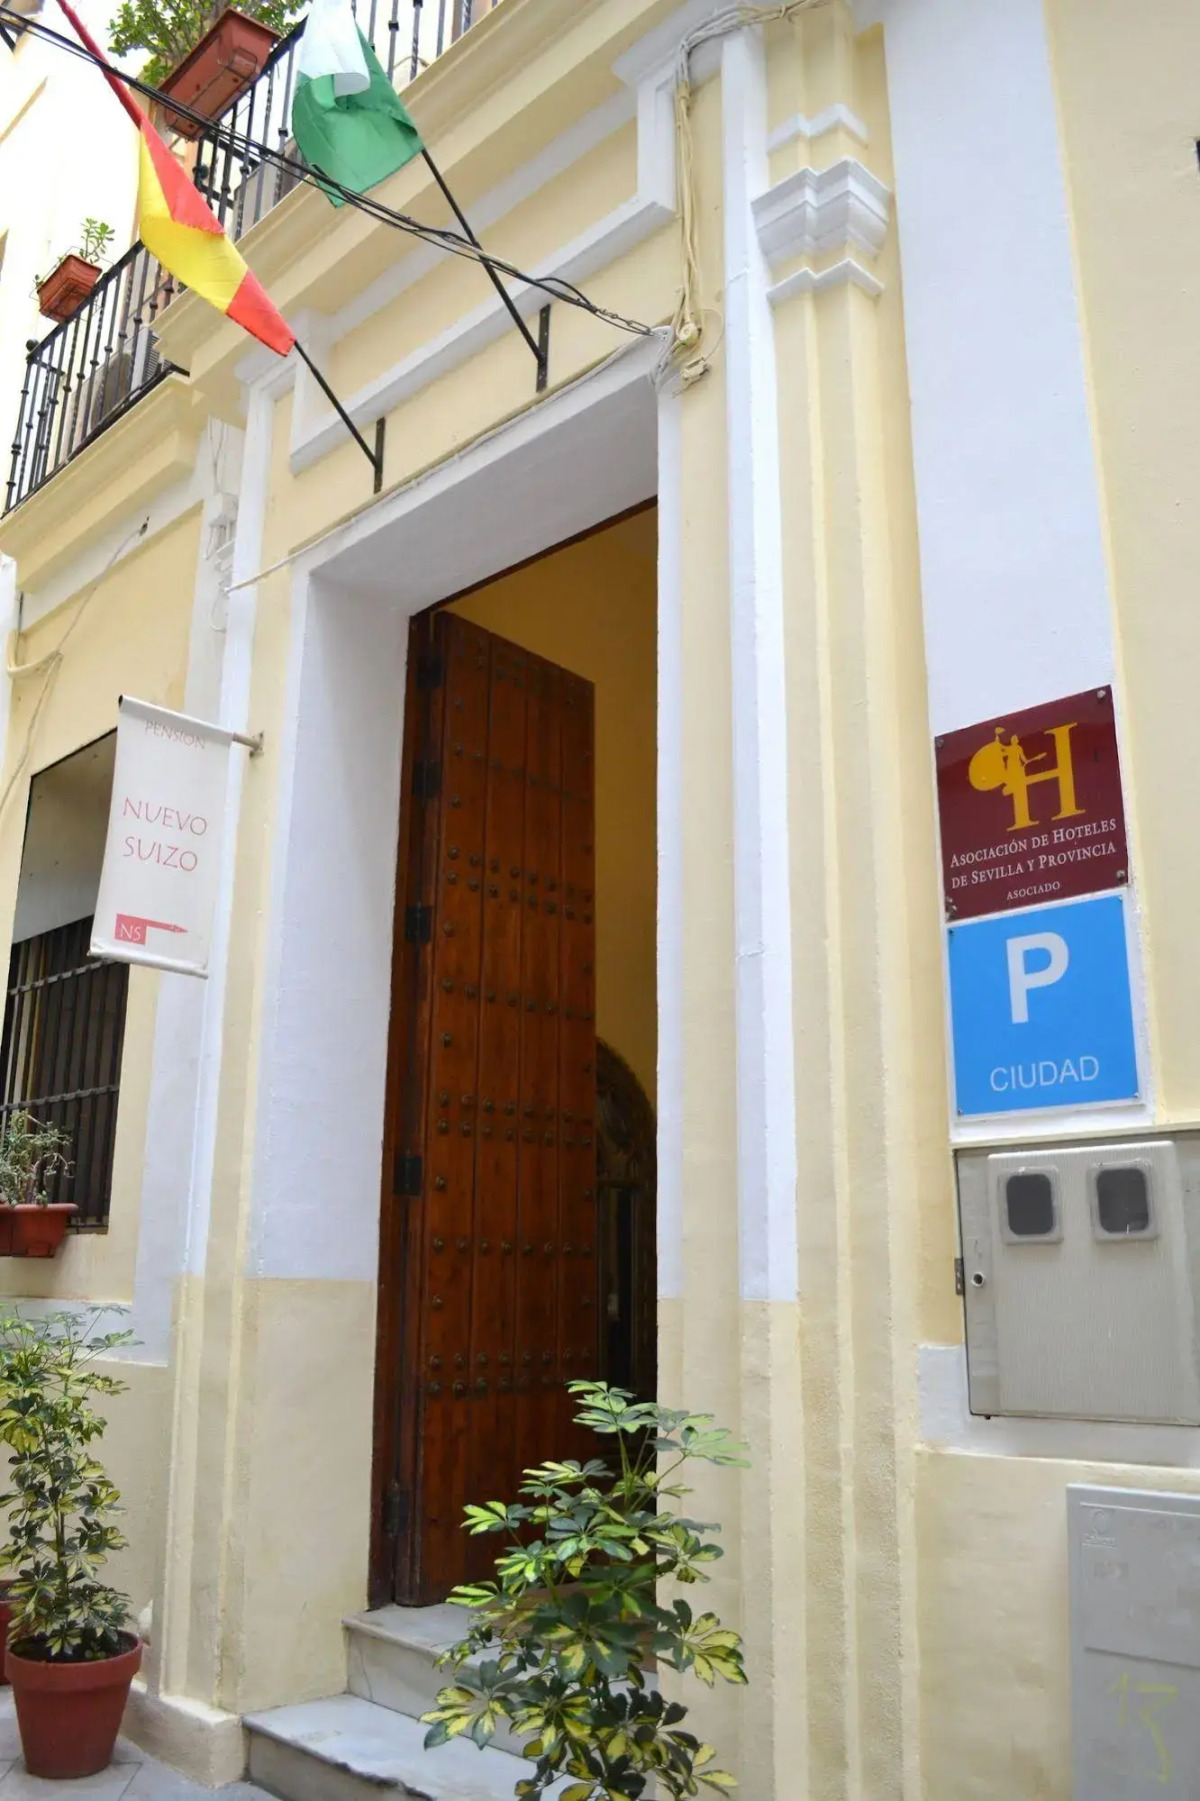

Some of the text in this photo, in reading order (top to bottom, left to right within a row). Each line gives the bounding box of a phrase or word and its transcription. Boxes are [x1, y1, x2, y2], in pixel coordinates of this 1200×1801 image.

[122, 797, 207, 836] NUEVO
[123, 836, 198, 872] SUIZO
[950, 818, 1117, 868] ASOCIACIÓN DE HOTELES
[951, 841, 1117, 889] DE SEVILLA Y PROVINCIA
[1006, 881, 1062, 900] ASOCIADO
[118, 923, 141, 942] NS
[1006, 931, 1069, 1024] P
[990, 1056, 1099, 1092] CIUDAD
